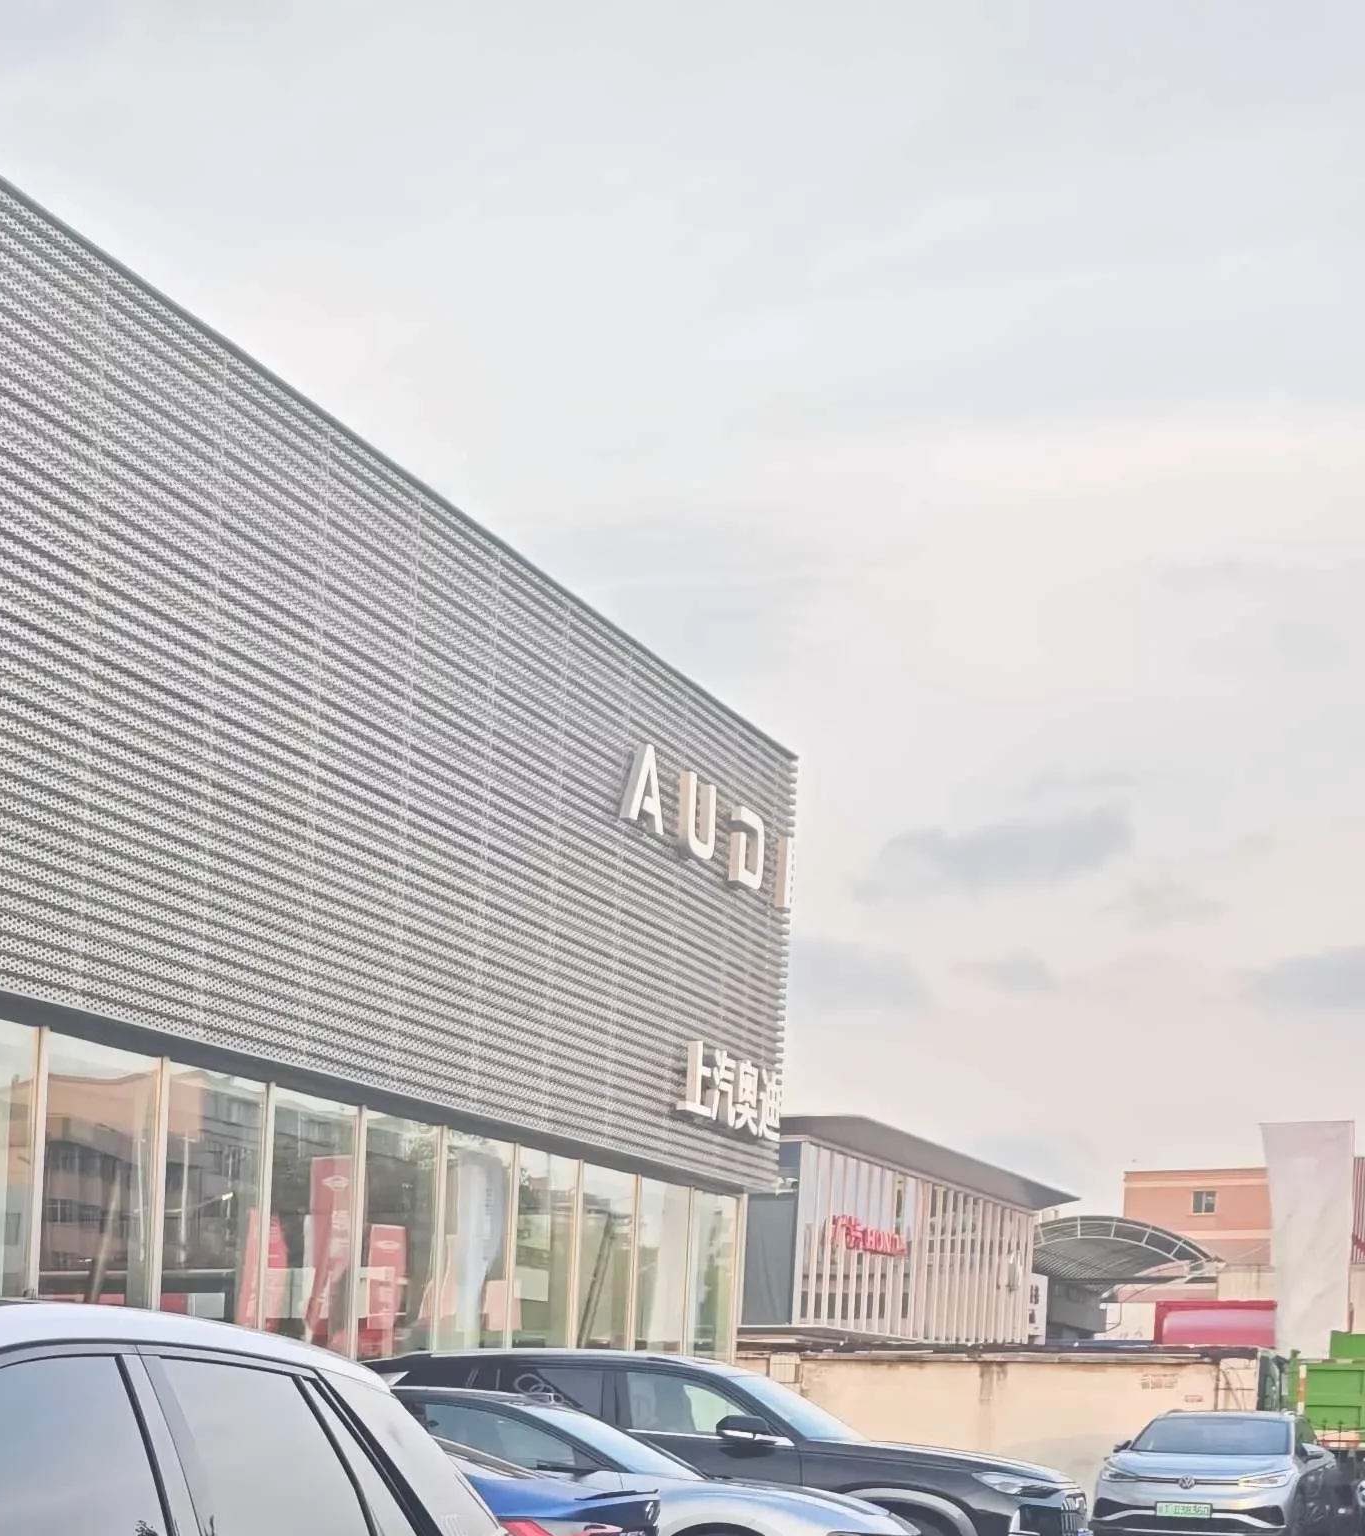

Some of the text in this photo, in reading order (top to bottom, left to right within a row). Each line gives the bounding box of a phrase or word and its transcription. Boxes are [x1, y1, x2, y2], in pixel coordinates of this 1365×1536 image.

[619, 743, 796, 908] AUDI
[676, 1040, 784, 1141] 上汽奥迪
